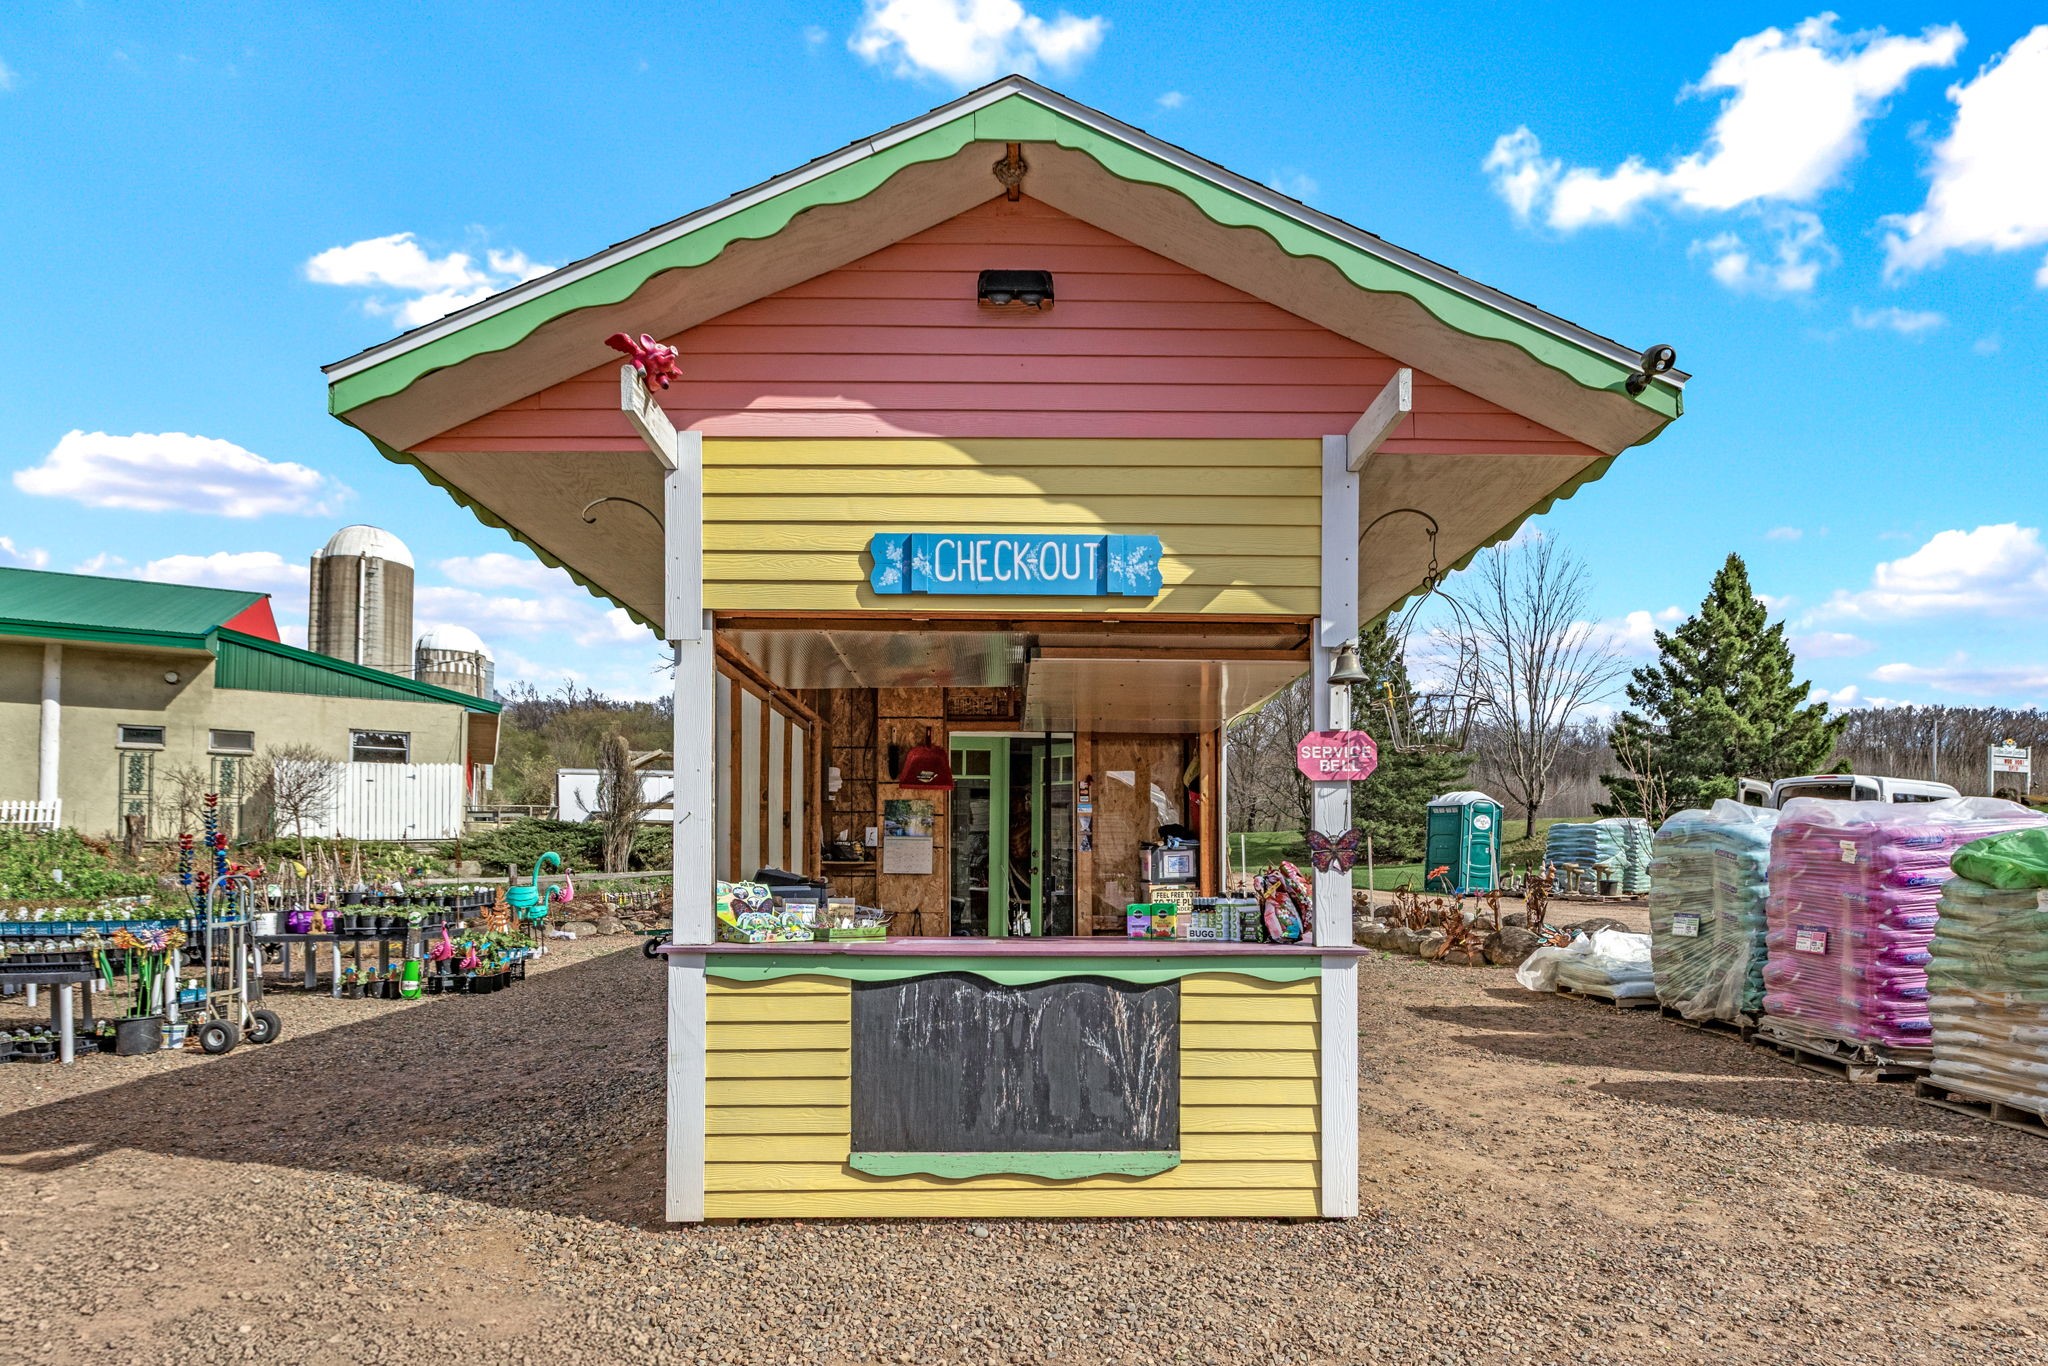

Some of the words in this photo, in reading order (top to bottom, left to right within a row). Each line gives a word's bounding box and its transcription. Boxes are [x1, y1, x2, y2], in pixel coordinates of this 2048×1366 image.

[1301, 745, 1373, 759] SERVICE
[1319, 759, 1361, 772] BELL
[1189, 930, 1215, 938] BUGG
